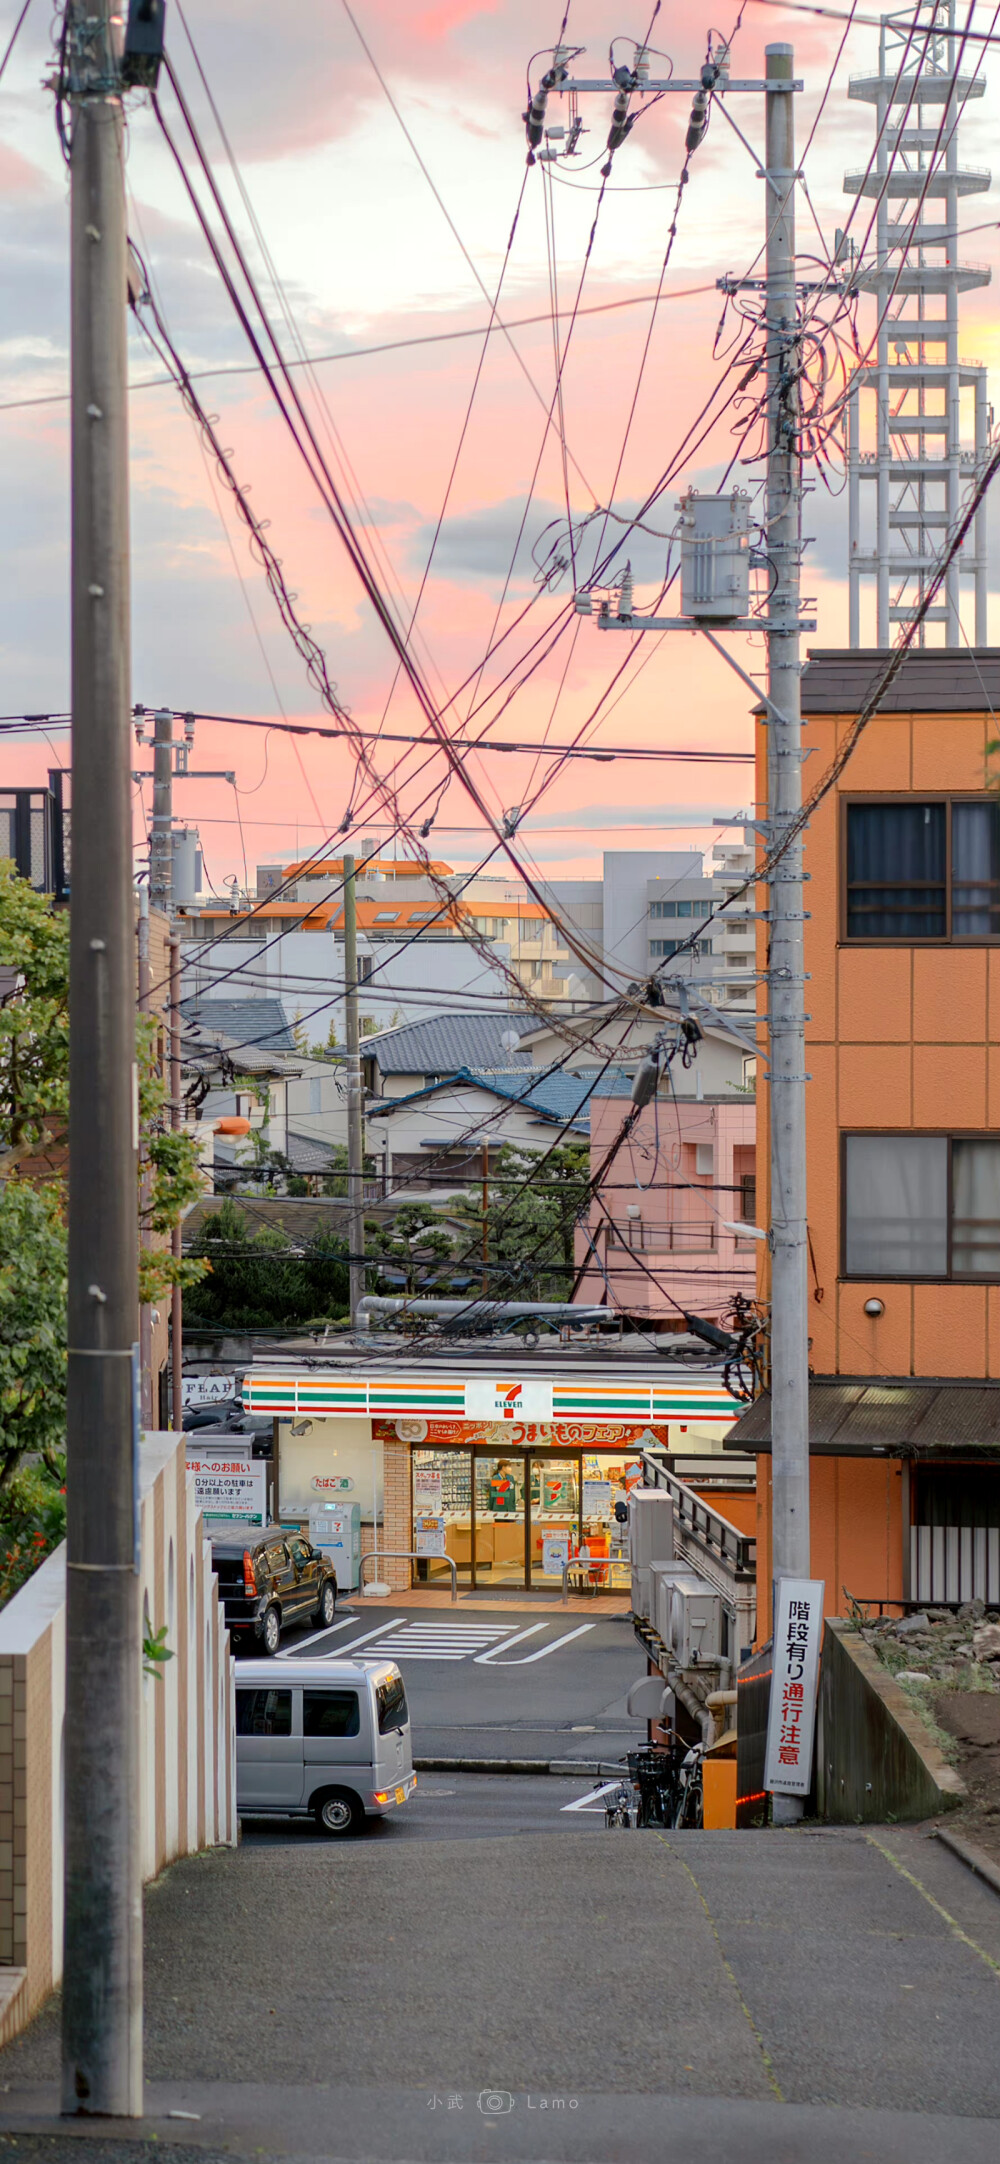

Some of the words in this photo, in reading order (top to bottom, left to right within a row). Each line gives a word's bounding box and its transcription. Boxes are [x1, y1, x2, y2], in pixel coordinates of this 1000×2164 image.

[511, 1422, 625, 1445] うまいものフェア
[315, 1478, 336, 1488] たばこ
[340, 1478, 349, 1488] 酒
[195, 1487, 242, 1496] 遠慮願います
[777, 1600, 811, 1766] 階段有り通行注意
